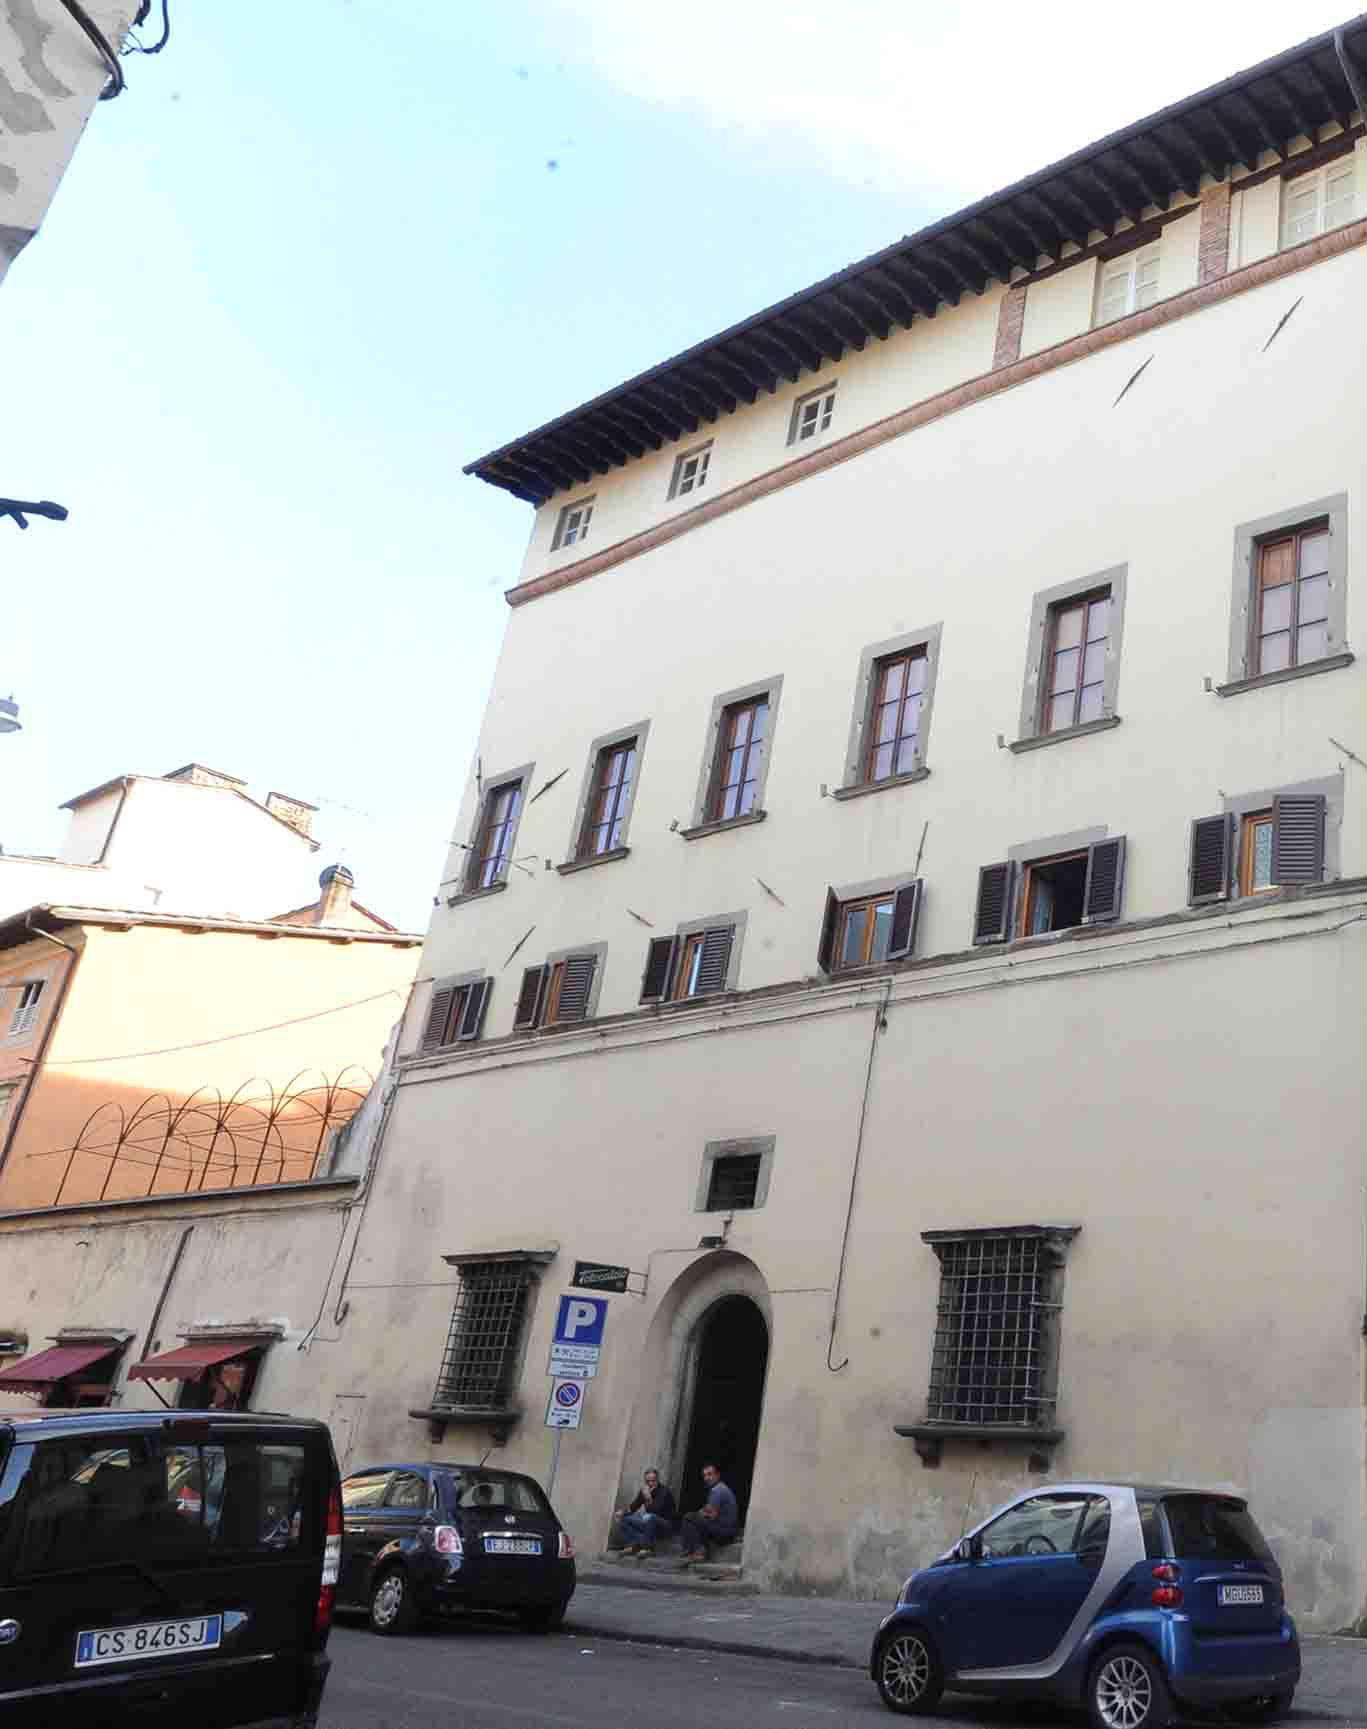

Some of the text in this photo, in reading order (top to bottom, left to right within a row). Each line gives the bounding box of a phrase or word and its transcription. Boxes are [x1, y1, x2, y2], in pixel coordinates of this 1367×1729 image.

[564, 1300, 597, 1338] P
[96, 1621, 205, 1656] CS 846SJ
